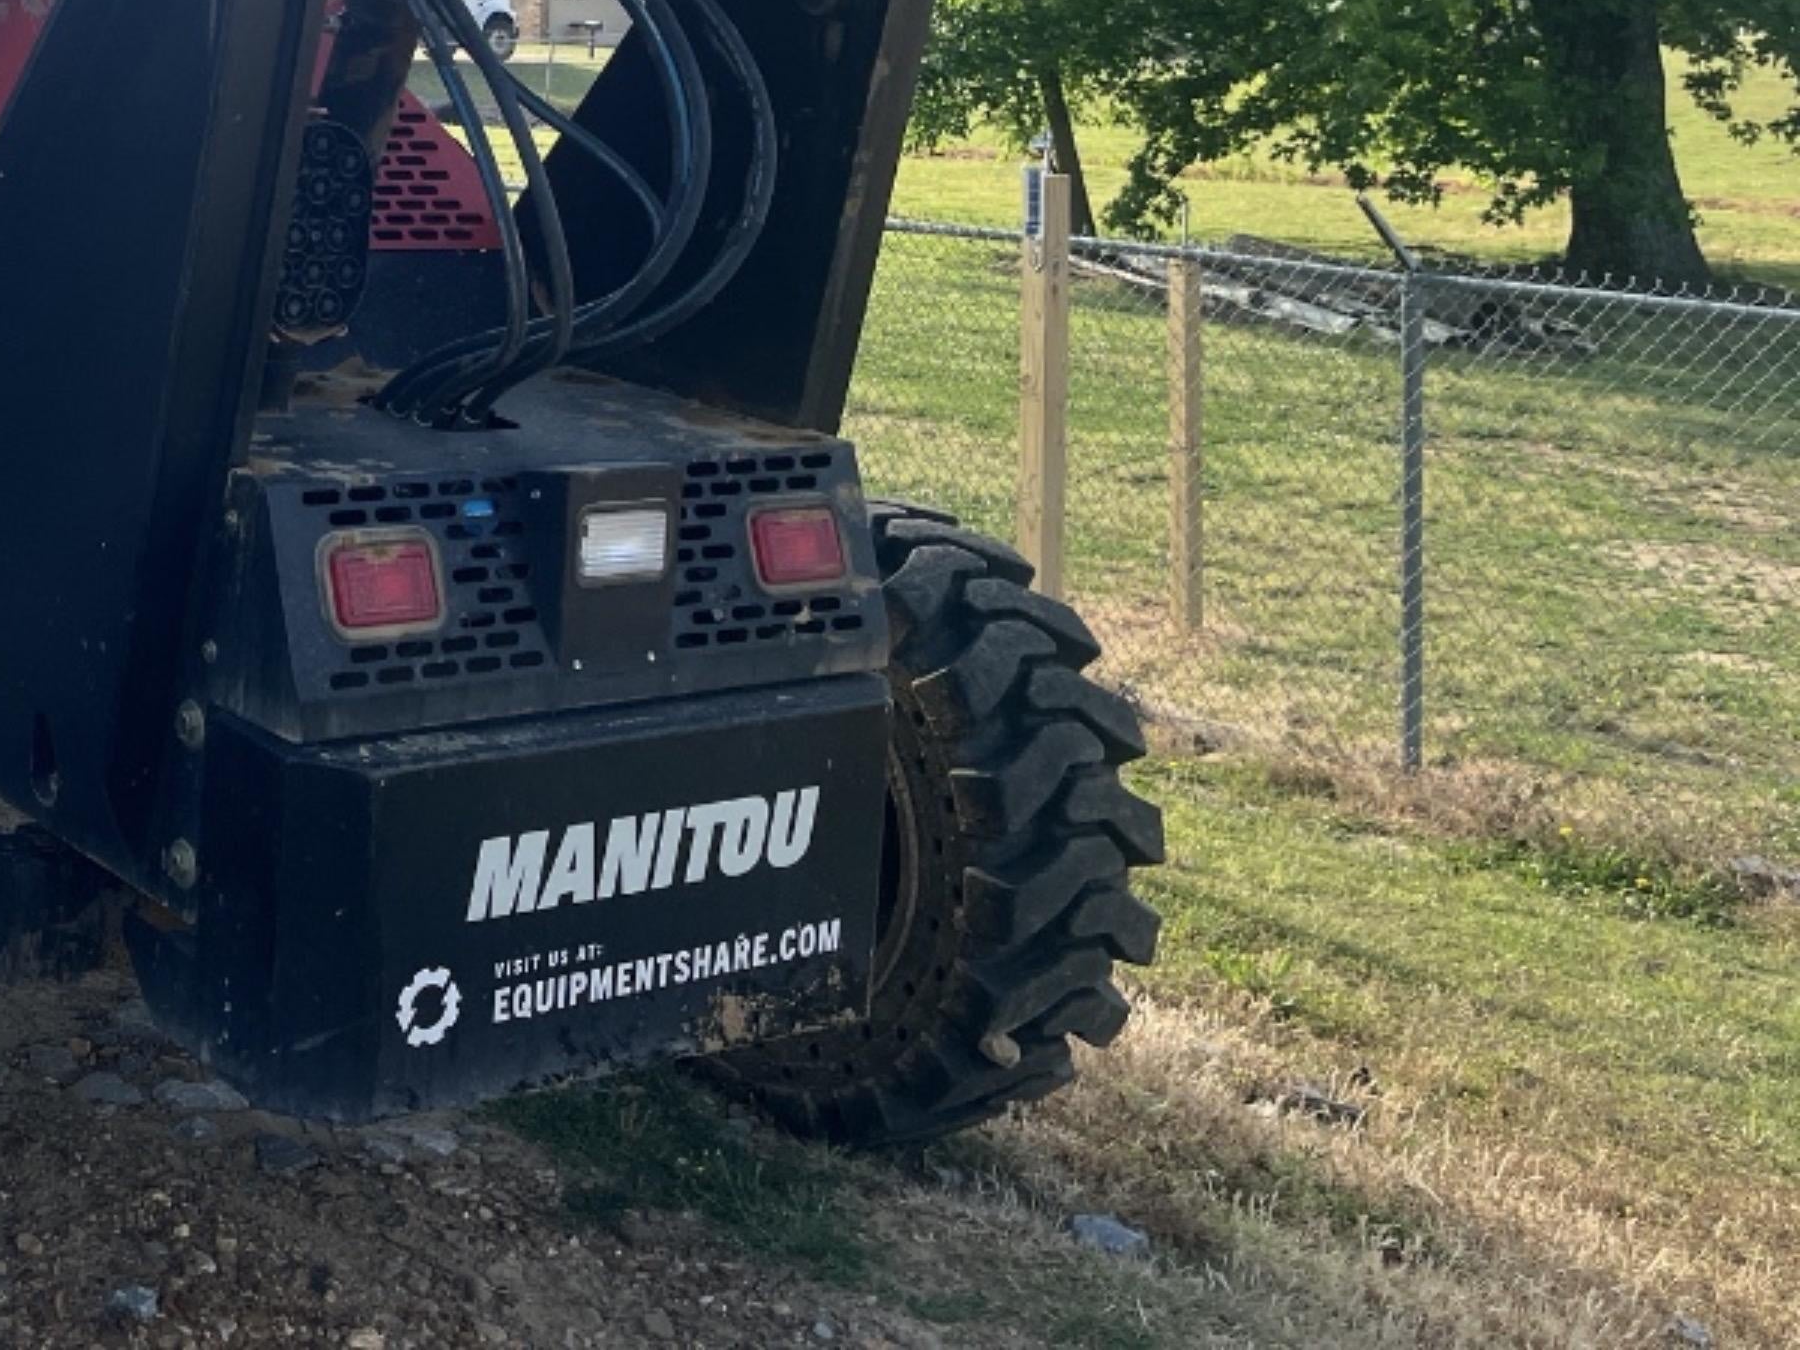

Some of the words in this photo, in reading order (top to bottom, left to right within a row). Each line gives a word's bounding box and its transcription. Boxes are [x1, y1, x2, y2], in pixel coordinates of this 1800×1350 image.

[465, 784, 820, 922] MANITOU
[491, 917, 842, 1024] EQUIPMENTSHARE.COM
[494, 953, 541, 979] VISIT
[547, 948, 568, 967] US
